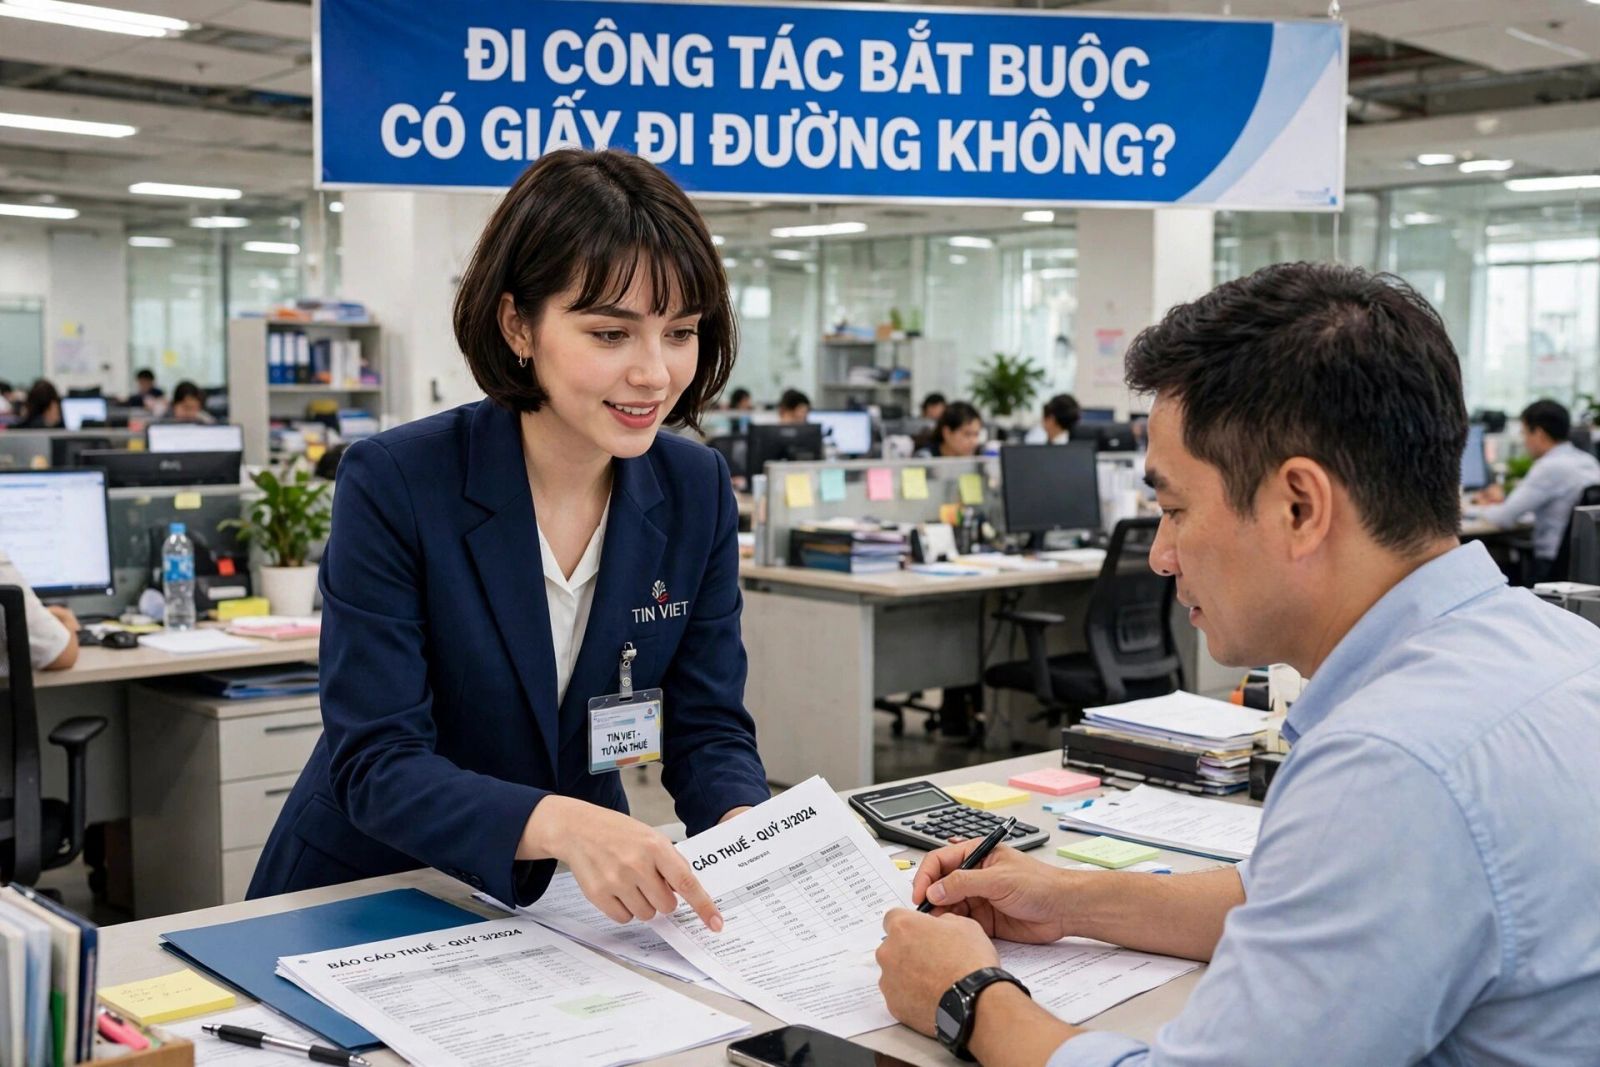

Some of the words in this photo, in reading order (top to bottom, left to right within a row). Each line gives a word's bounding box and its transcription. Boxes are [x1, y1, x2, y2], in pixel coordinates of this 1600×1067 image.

[465, 28, 526, 82] ĐI
[543, 18, 714, 88] CÔNG
[728, 23, 844, 91] TÁC
[859, 19, 974, 95] BẮT
[989, 32, 1150, 113] BUỘC
[381, 91, 466, 160] CÓ
[481, 89, 622, 161] GIẤY
[635, 111, 694, 166] ĐI
[709, 101, 921, 171] ĐƯỜNG
[937, 107, 1176, 177] KHÔNG?
[631, 608, 656, 624] TIN
[658, 601, 689, 619] VIET
[607, 731, 620, 742] TIN
[692, 853, 718, 871] CÁO
[717, 835, 751, 860] THUẾ
[780, 806, 817, 829] 3/2024
